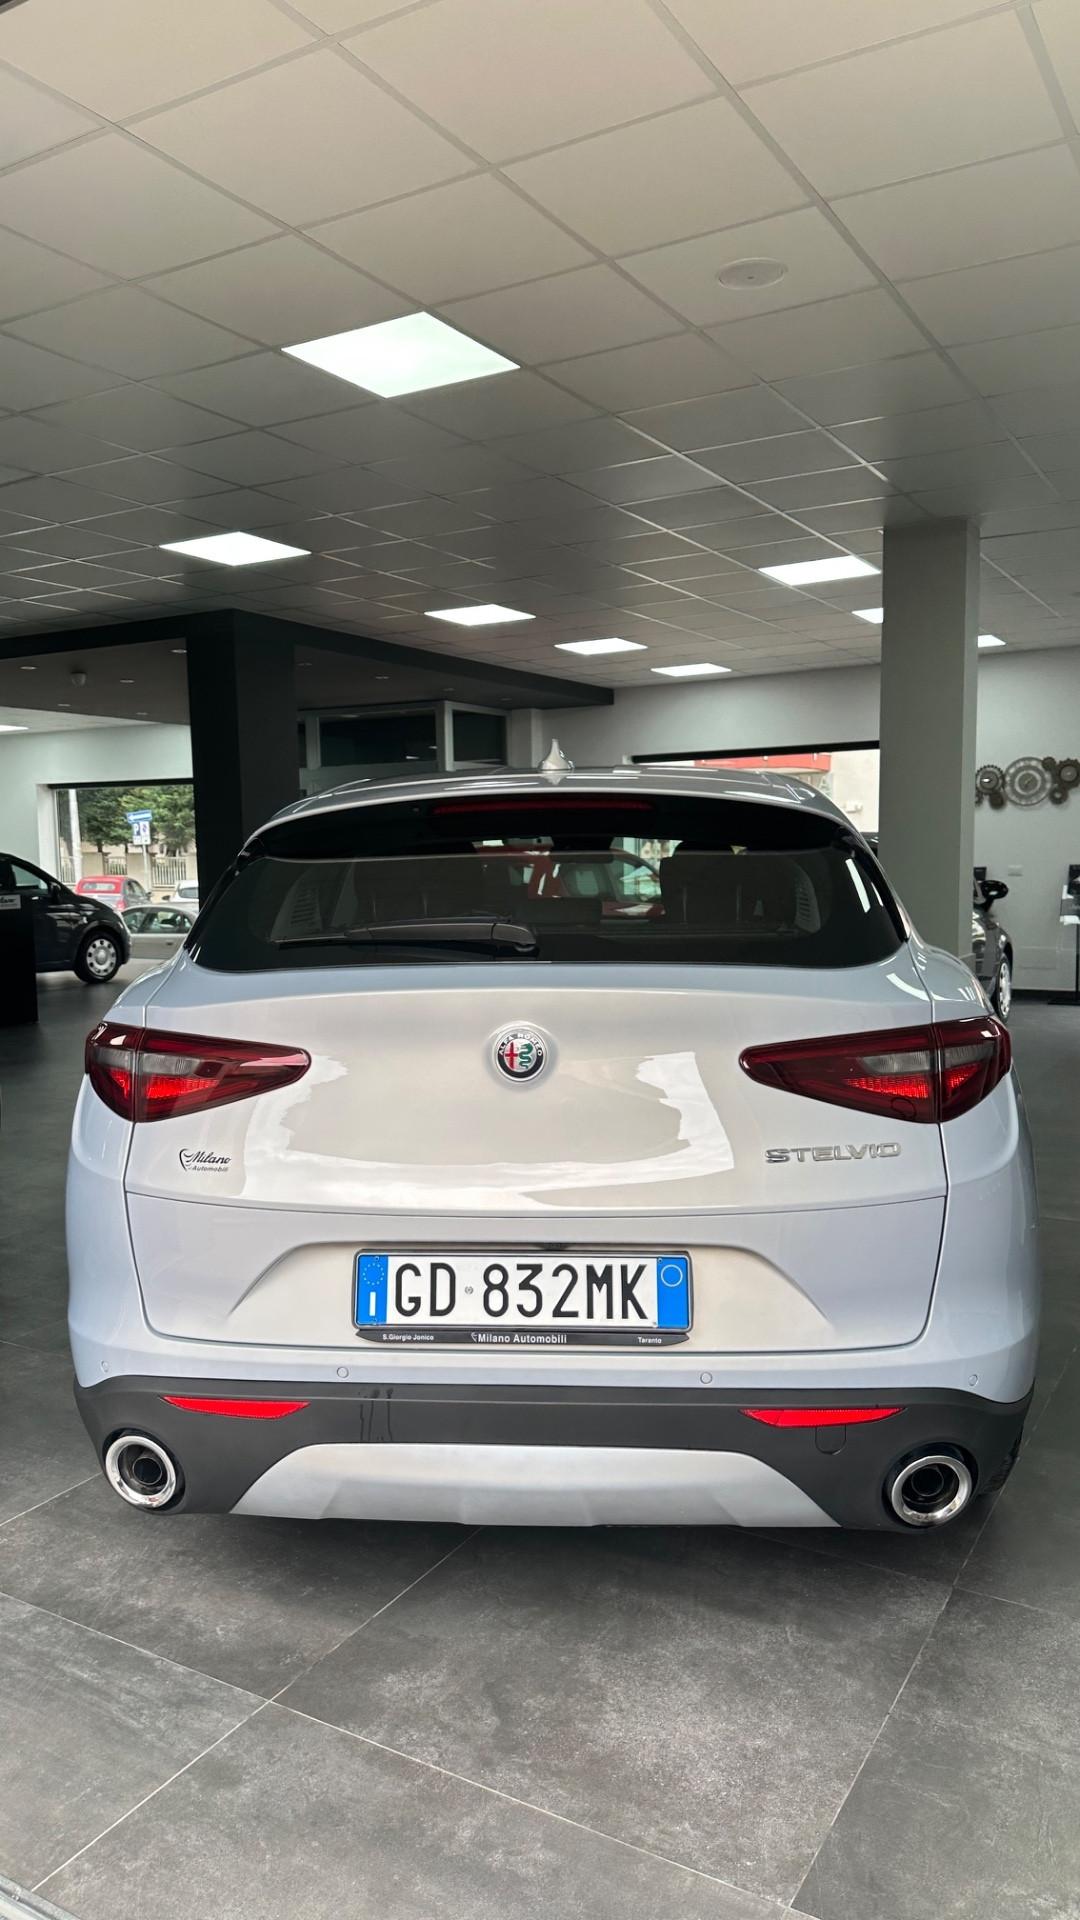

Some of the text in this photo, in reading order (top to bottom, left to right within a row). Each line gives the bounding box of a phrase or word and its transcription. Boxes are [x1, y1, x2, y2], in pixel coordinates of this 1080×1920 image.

[189, 1150, 232, 1164] Milano
[765, 1142, 902, 1164] STELVIO
[395, 1262, 649, 1320] GD 832MK
[478, 1333, 568, 1345] Milano Automobili
[637, 1336, 662, 1344] Taranto
